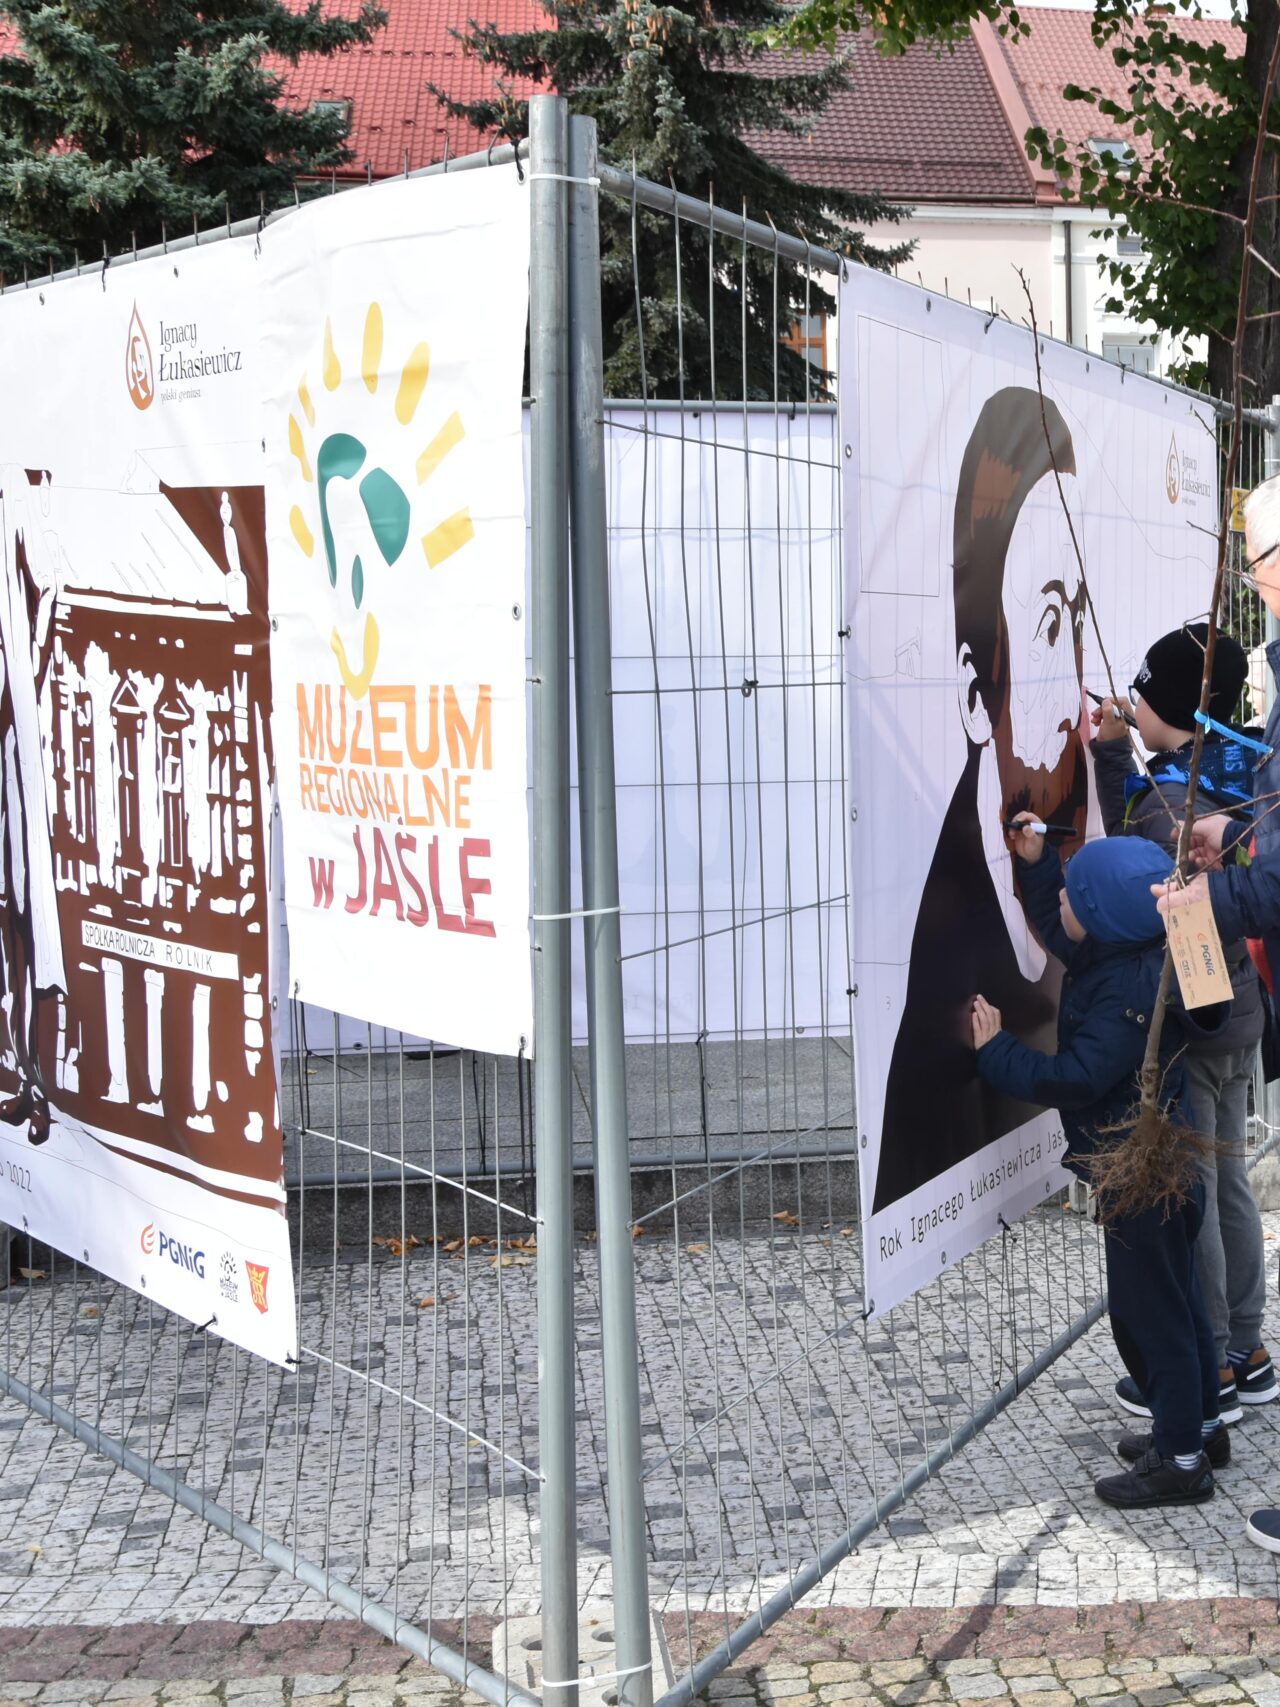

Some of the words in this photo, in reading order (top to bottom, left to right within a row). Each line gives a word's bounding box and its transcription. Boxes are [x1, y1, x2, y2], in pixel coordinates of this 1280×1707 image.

[160, 321, 197, 352] Ignacy
[159, 346, 242, 382] Łukasiewicz
[296, 683, 493, 770] MUZEUM
[299, 763, 471, 829] REGIONALNE
[166, 944, 213, 972] ROLNIK
[1200, 944, 1216, 976] PGNiG
[6, 1160, 32, 1193] 2022
[879, 1227, 903, 1262] Rok
[911, 1191, 965, 1243] Ignacego
[970, 1142, 1042, 1203] Łukasiewicza
[1047, 1129, 1068, 1154] Jas
[158, 1230, 205, 1279] PGNiG
